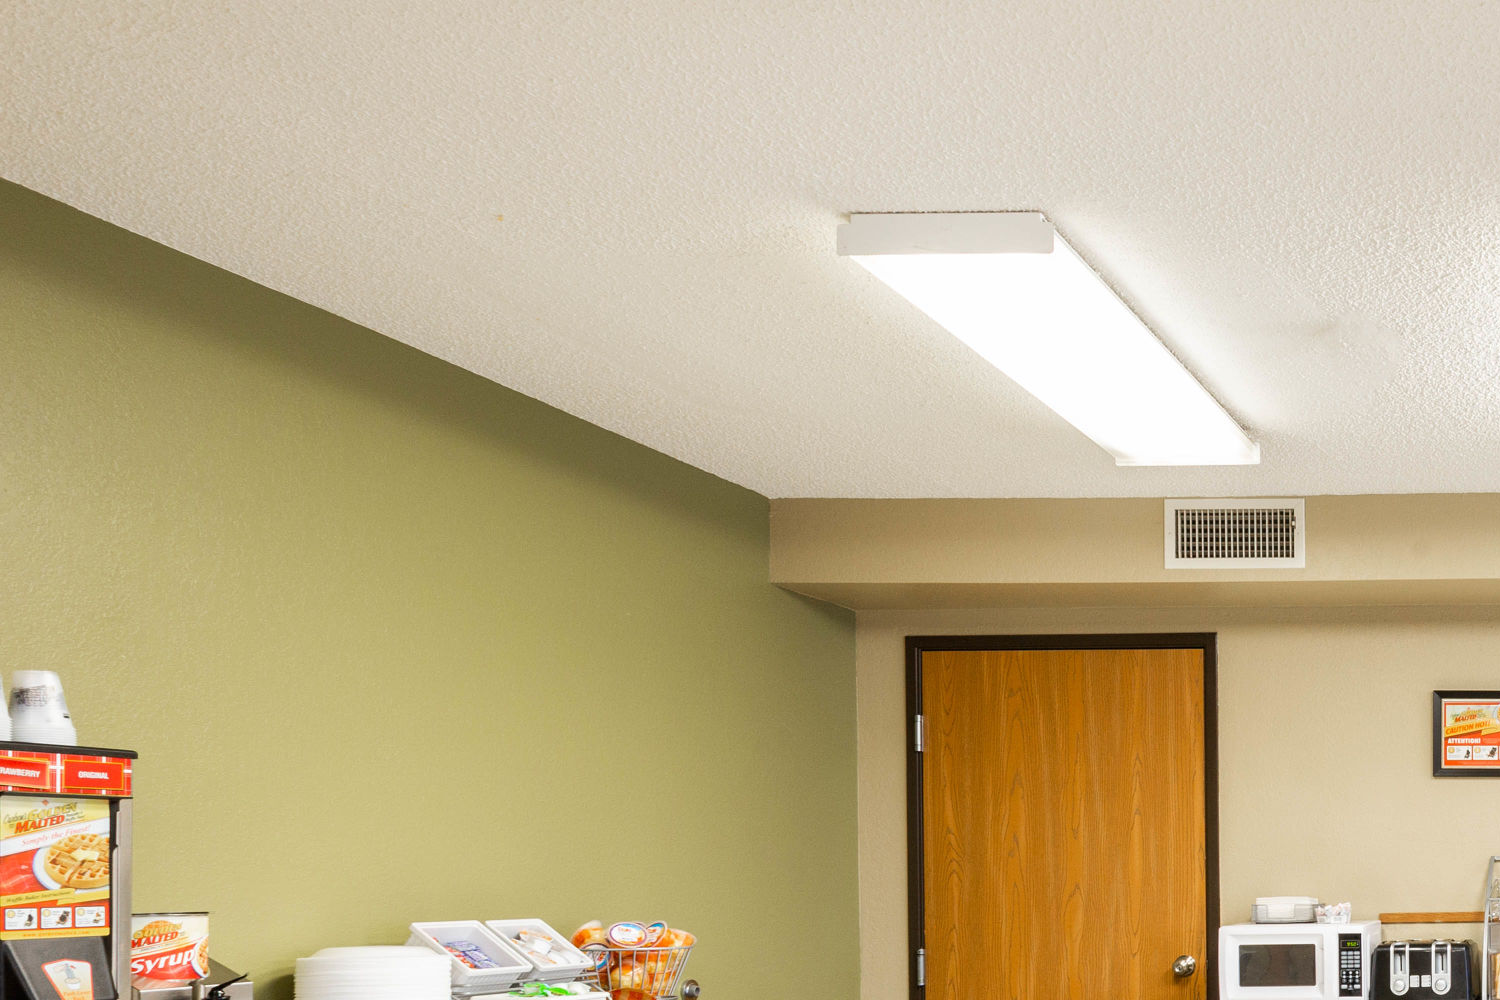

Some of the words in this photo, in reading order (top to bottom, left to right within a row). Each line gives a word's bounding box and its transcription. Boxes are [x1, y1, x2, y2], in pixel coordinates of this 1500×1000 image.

[1446, 724, 1474, 735] CAUTION
[78, 771, 109, 779] ORIGINAL
[28, 802, 77, 820] GOLDEN
[14, 815, 65, 834] MALTED
[131, 931, 179, 949] MALTED
[131, 950, 195, 974] Syrup
